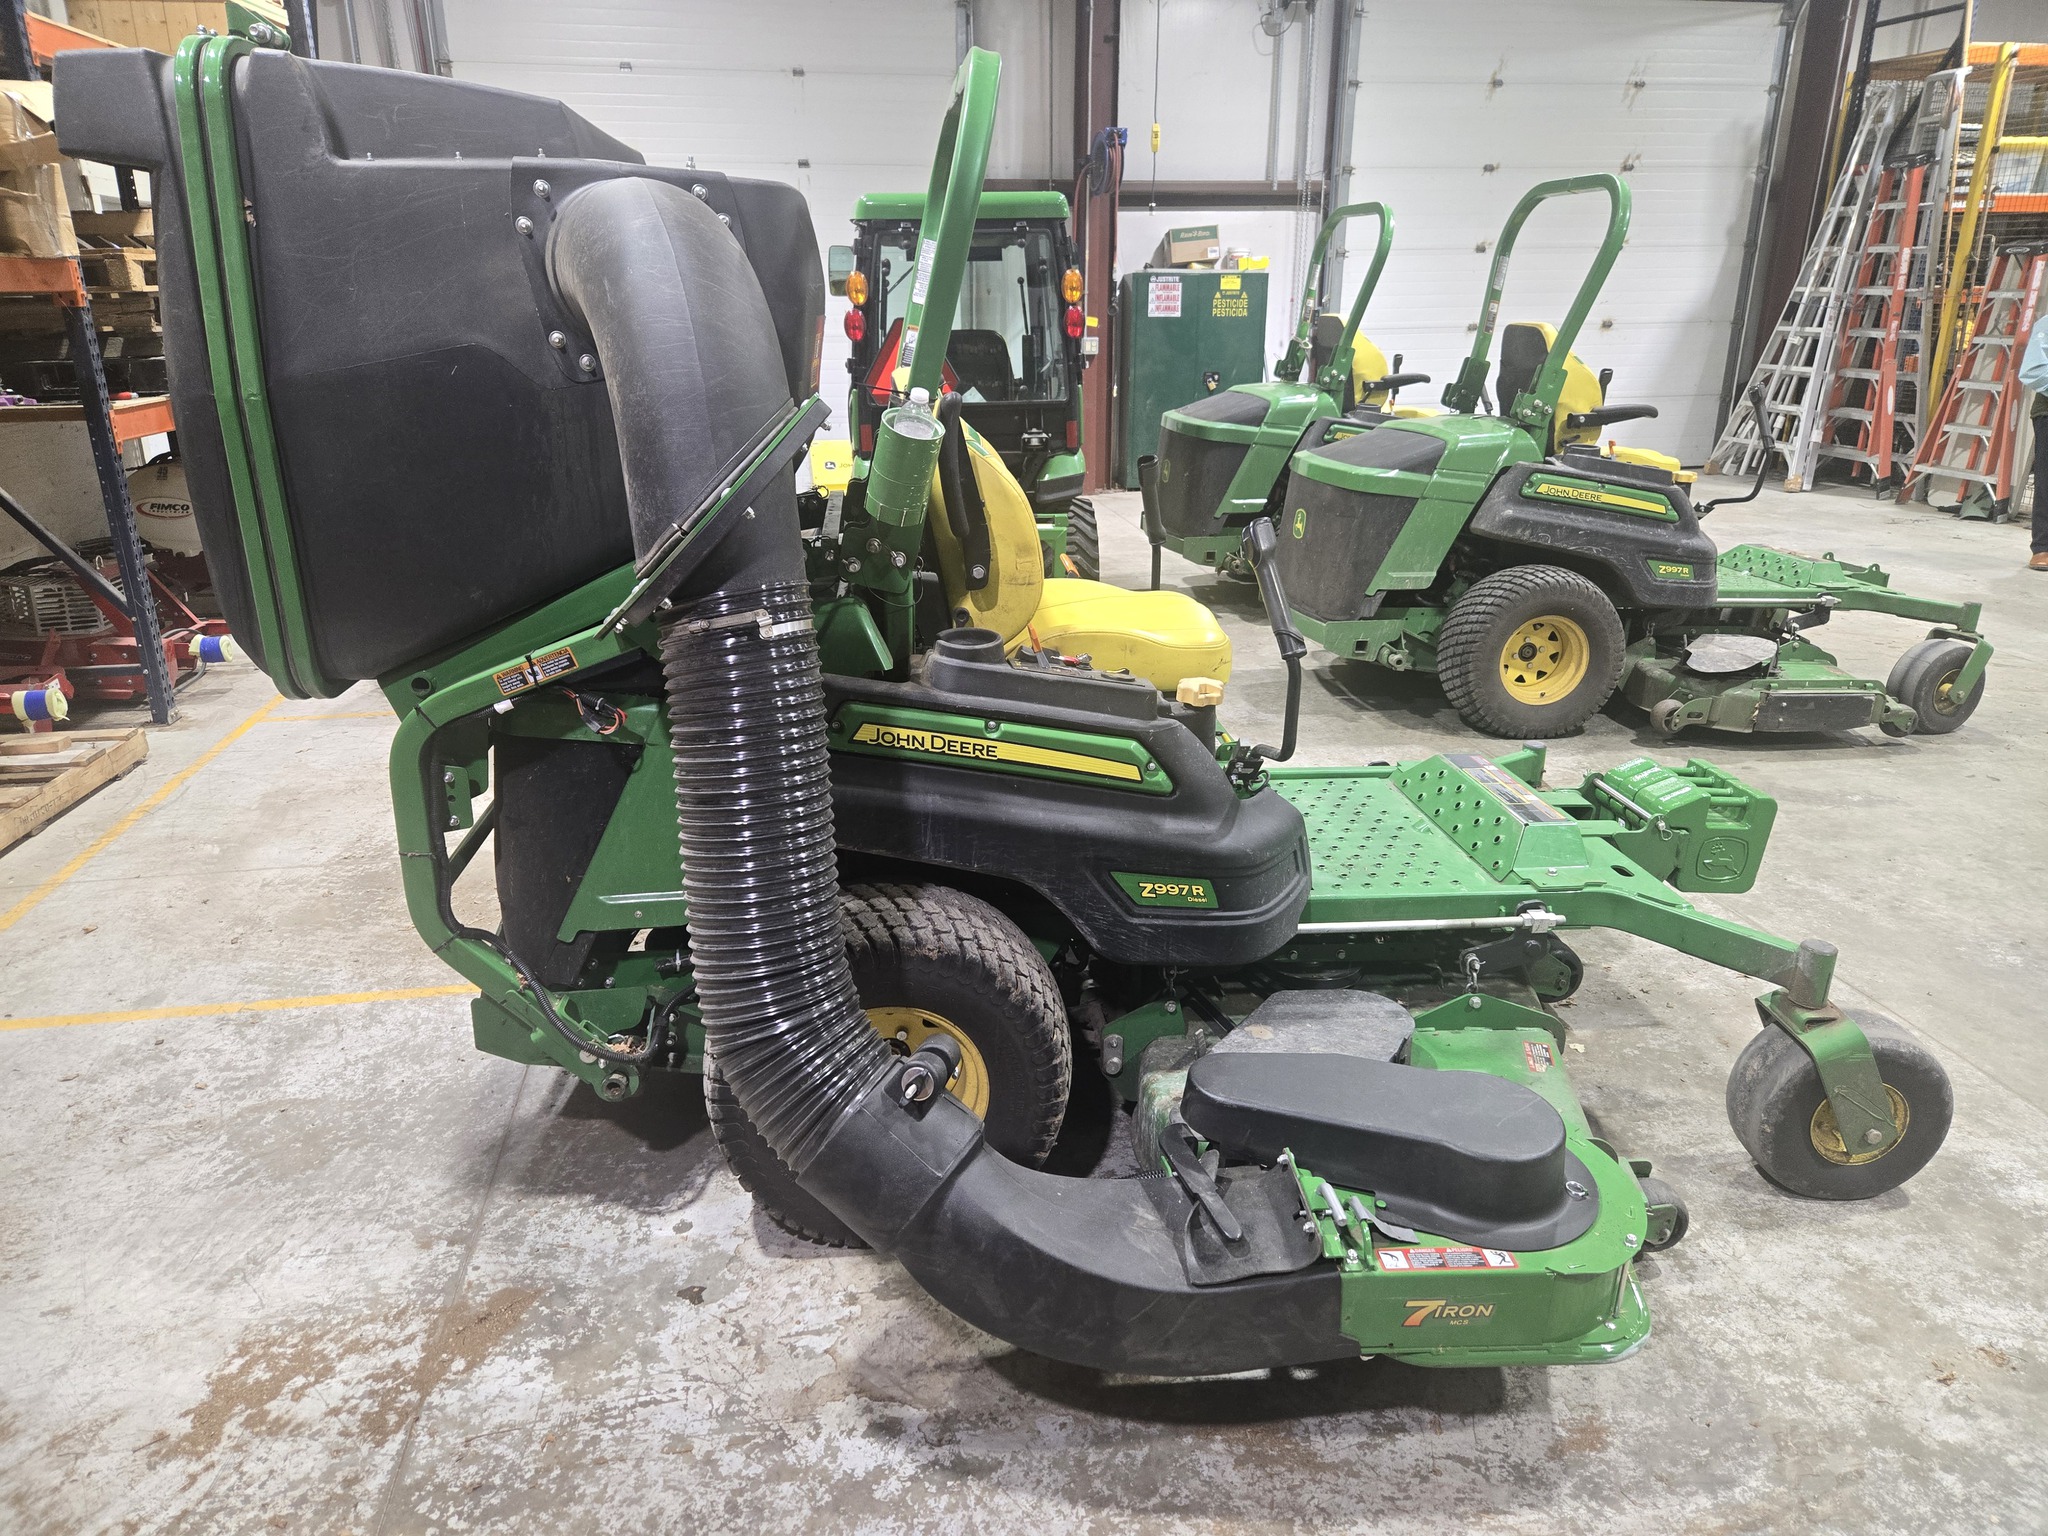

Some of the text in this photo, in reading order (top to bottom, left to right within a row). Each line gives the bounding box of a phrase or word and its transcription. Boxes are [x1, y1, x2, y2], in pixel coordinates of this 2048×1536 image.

[1212, 299, 1249, 308] PESTICIDE
[1212, 308, 1248, 317] PESTICIDA
[1543, 485, 1603, 502] JOHN DEERE
[149, 502, 190, 511] FIMCO
[1658, 565, 1690, 575] Z997R
[868, 727, 999, 758] JOHN DEERE
